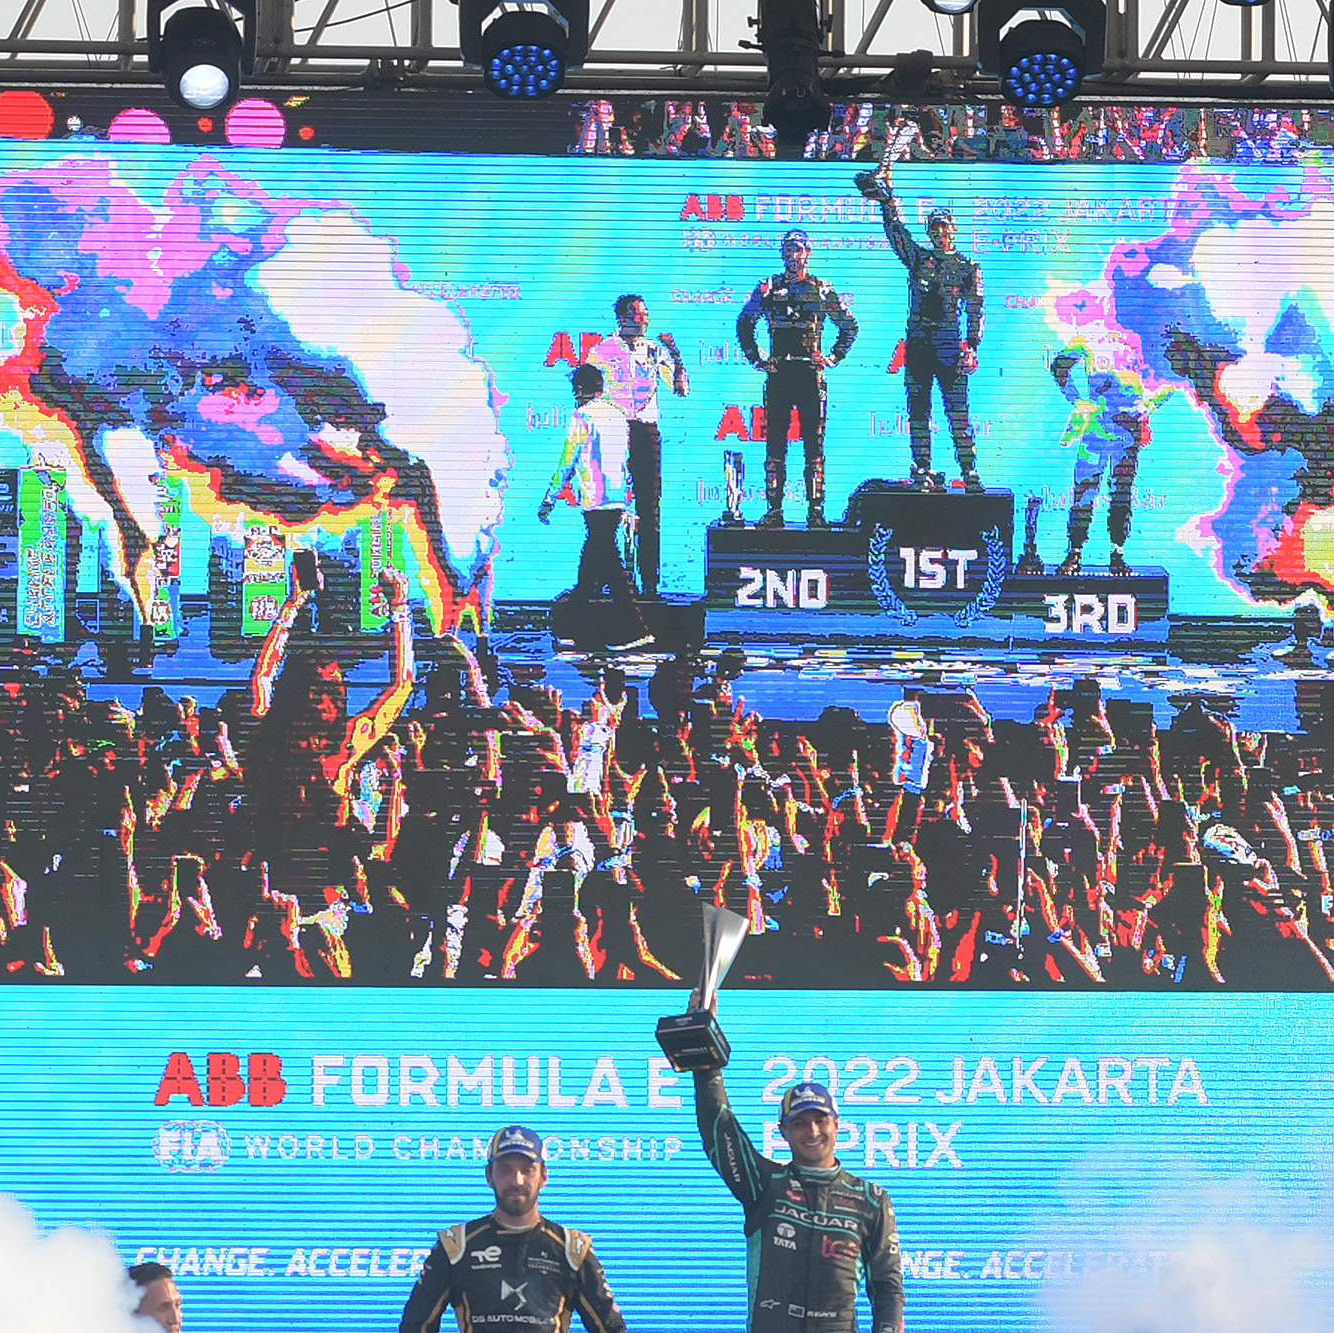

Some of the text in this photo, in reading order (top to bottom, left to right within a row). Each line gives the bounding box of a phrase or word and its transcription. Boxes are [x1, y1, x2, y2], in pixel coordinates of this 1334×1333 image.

[734, 565, 829, 610] 2ND
[898, 546, 978, 589] 1ST
[1043, 592, 1137, 634] 3RD
[155, 1052, 286, 1106] ABB
[311, 1054, 629, 1108] FORMULA
[762, 1055, 921, 1105] 2022
[935, 1056, 1210, 1106] JAKARTA
[246, 1134, 376, 1160] WORLD
[723, 1132, 742, 1184] JAGUAR
[774, 1205, 859, 1232] JAGUAR
[772, 1236, 798, 1251] TATA
